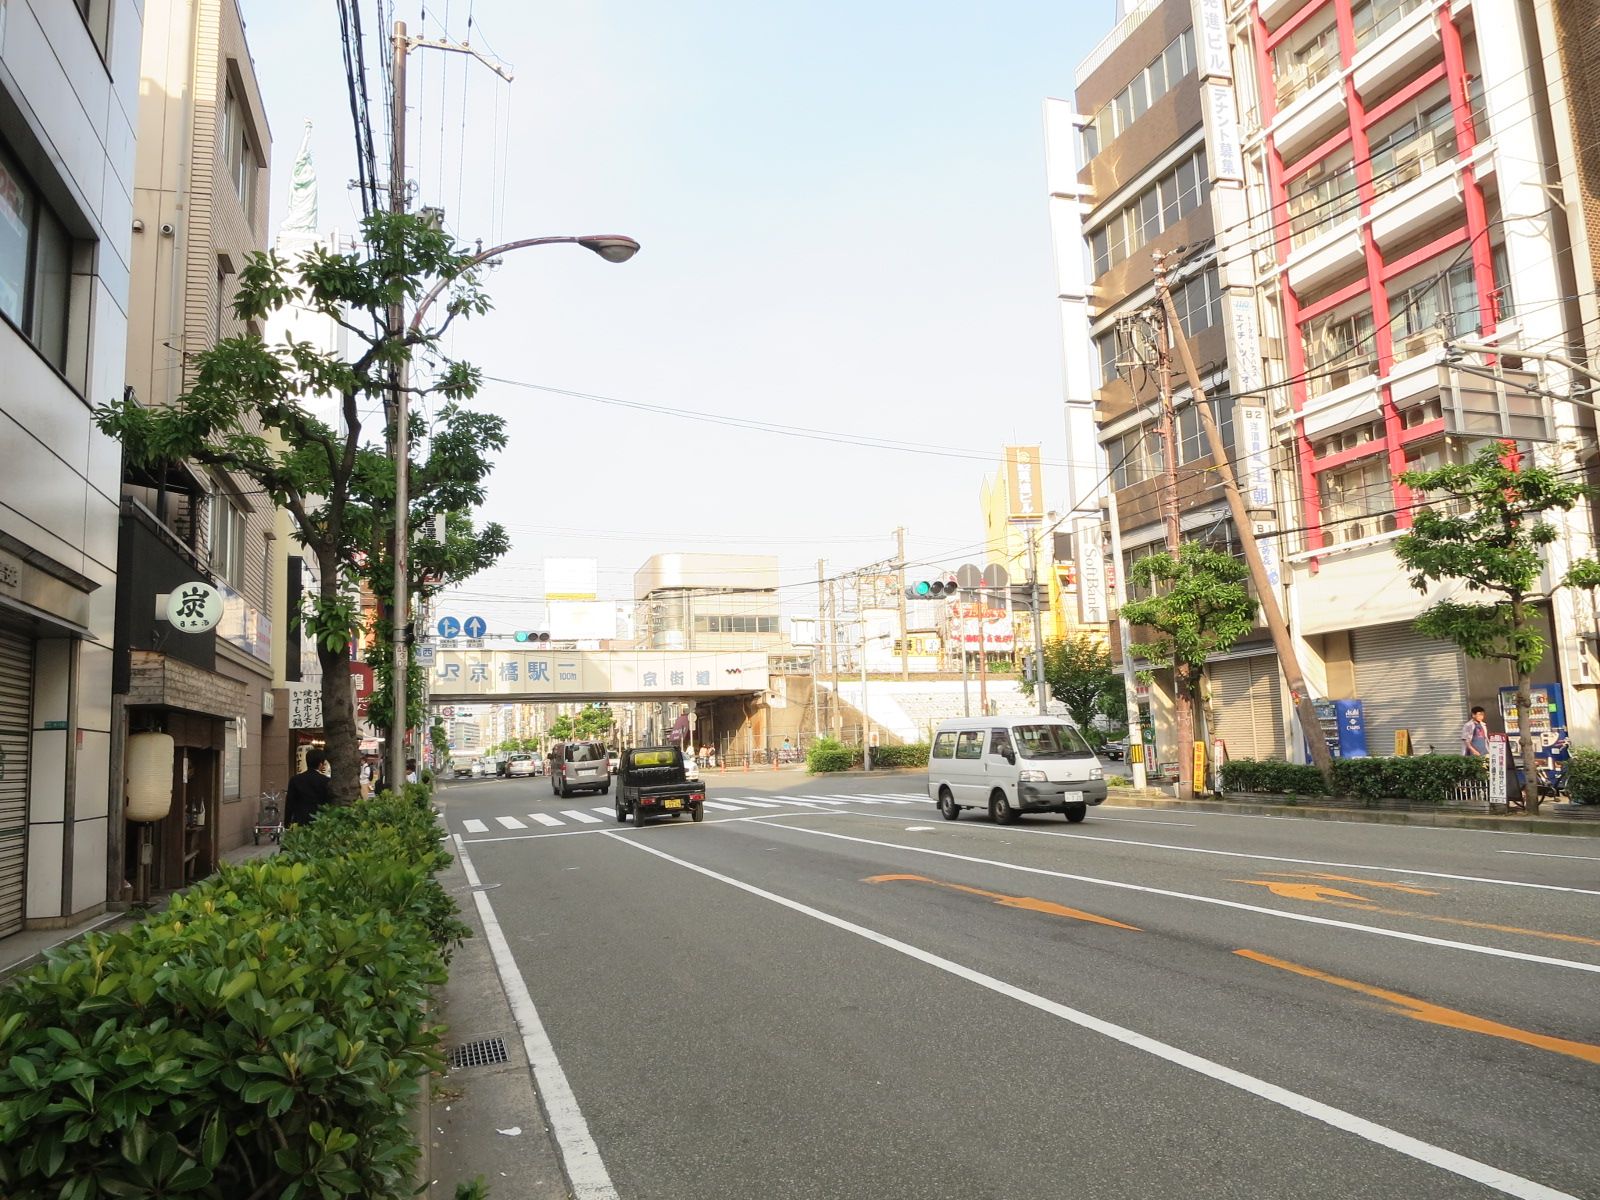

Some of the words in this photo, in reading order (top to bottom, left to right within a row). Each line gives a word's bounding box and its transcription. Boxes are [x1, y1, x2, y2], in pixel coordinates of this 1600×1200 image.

[1215, 89, 1235, 174] テナント募集
[176, 587, 210, 618] 炭
[1084, 547, 1101, 615] SoftBank
